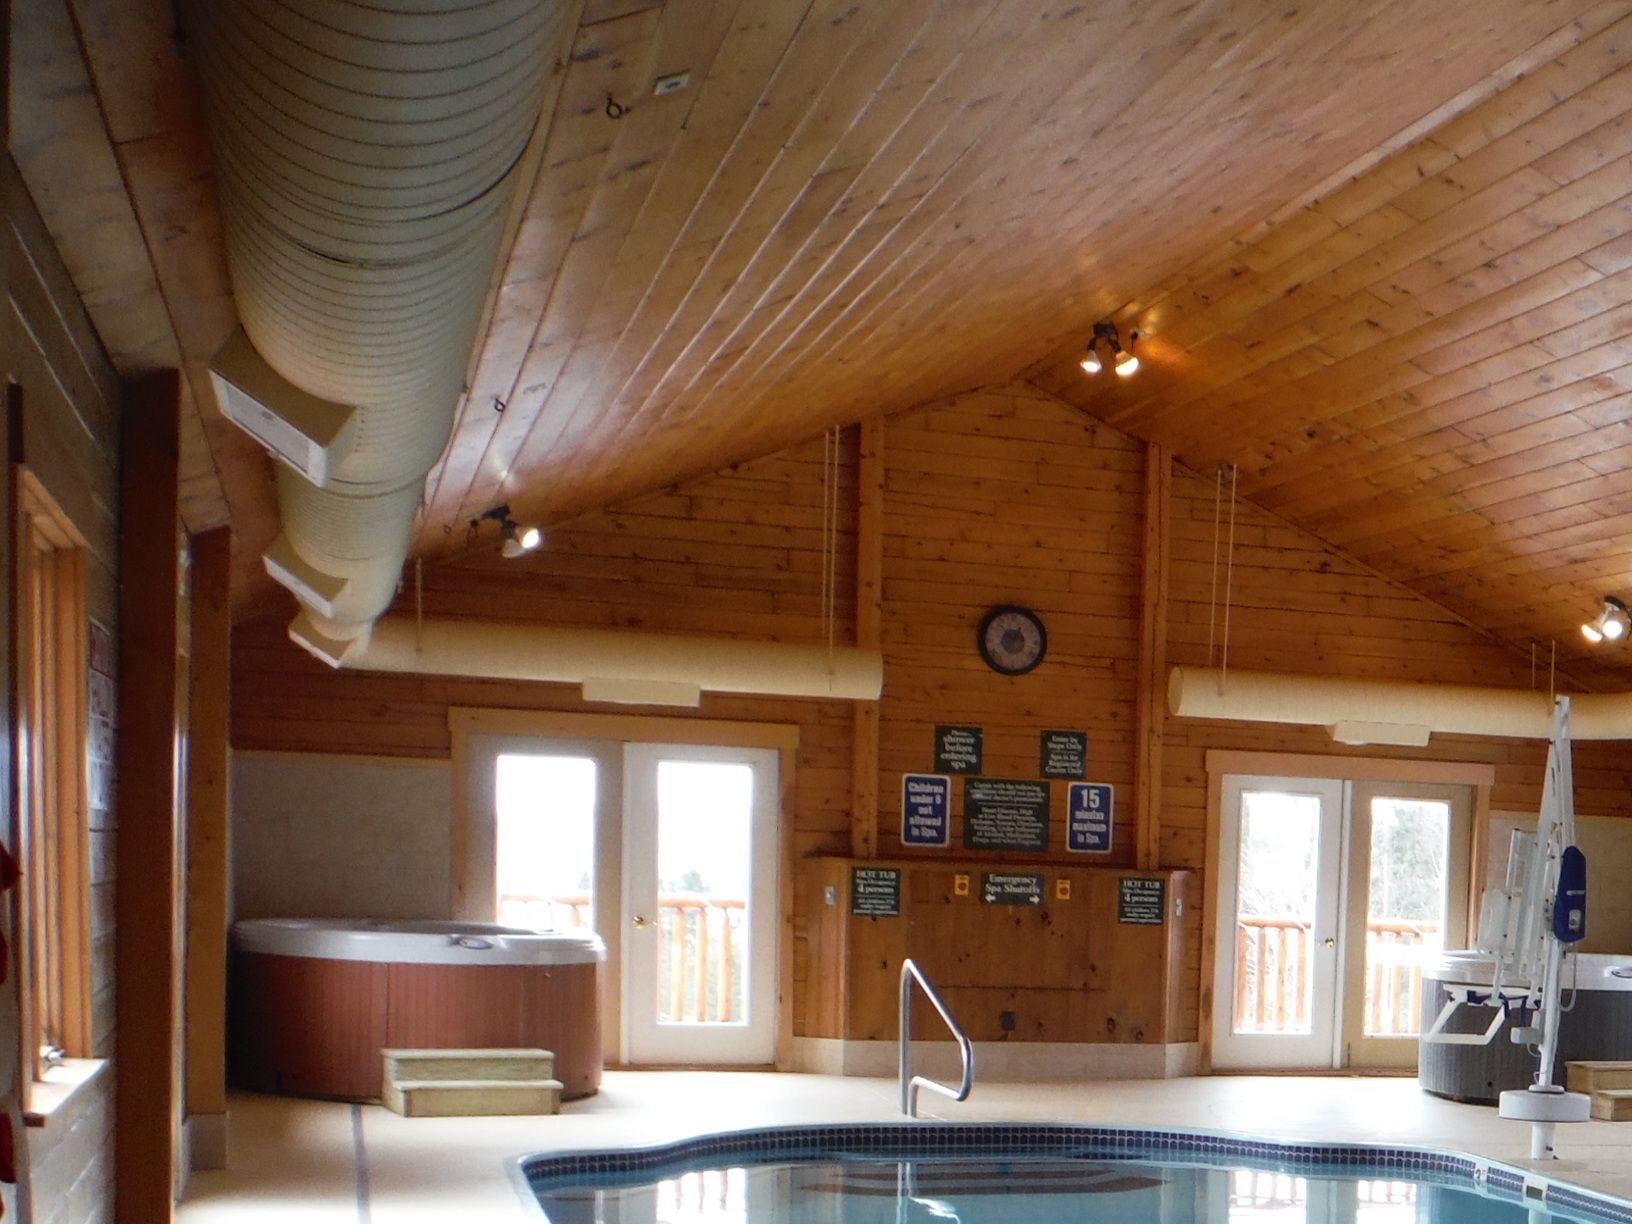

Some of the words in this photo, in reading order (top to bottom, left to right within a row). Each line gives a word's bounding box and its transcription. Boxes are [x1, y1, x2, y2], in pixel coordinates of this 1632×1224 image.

[945, 743, 974, 753] before
[940, 752, 977, 764] entering
[951, 761, 967, 770] spa
[908, 782, 945, 794] Children
[910, 794, 934, 804] under
[1080, 788, 1101, 809] 15
[918, 805, 933, 815] not
[1075, 810, 1105, 821] minutes
[909, 815, 942, 826] allowed
[911, 825, 920, 837] in
[1072, 822, 1107, 832] maximum
[1077, 832, 1085, 843] in
[856, 870, 876, 878] HOT
[879, 870, 896, 880] TUB
[988, 873, 1038, 886] Emergency
[857, 883, 865, 893] 4
[865, 886, 895, 894] persons
[985, 883, 1002, 894] Spa
[1123, 879, 1141, 888] HOT
[1144, 880, 1161, 890] TUB
[1124, 893, 1131, 903] 4
[1131, 895, 1159, 903] persons
